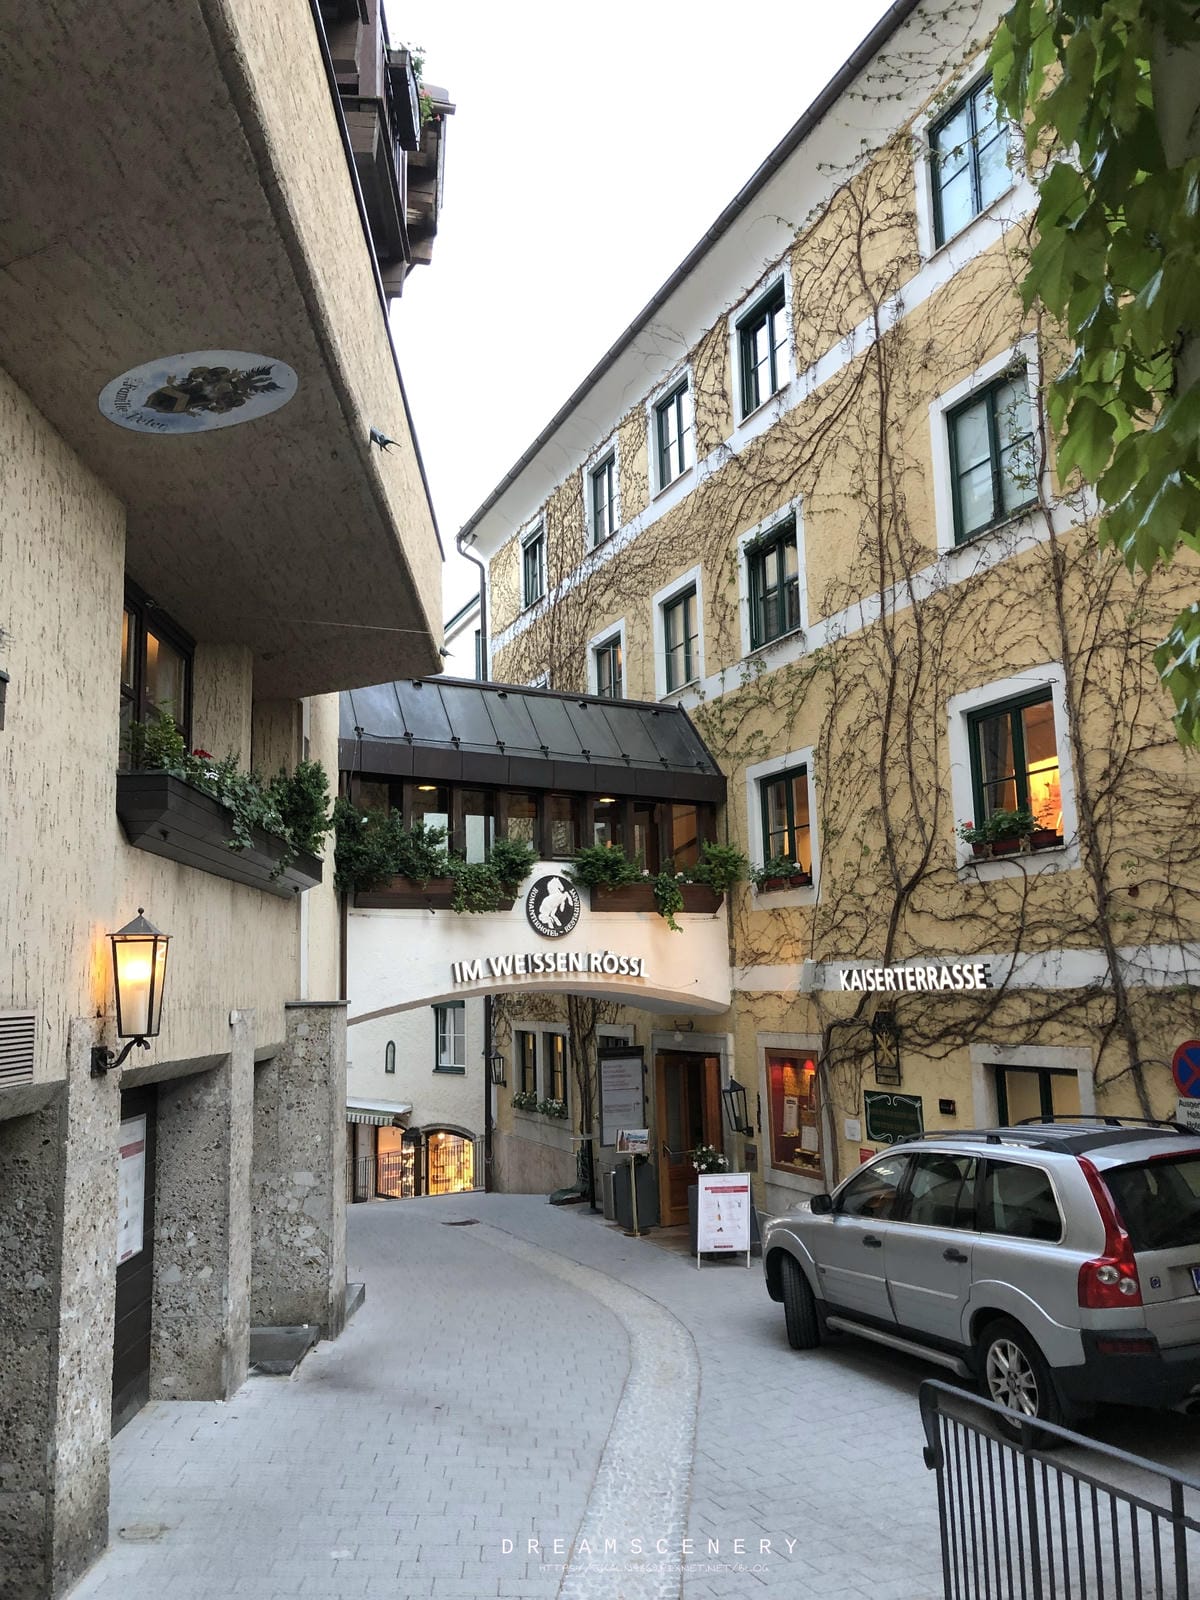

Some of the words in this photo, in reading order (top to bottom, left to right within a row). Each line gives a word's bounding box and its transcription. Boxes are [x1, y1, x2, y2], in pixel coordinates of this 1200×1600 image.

[452, 958, 484, 983] IM
[487, 952, 583, 978] WEISSEN
[588, 950, 649, 978] RÖSSL
[839, 963, 987, 992] KAISERTERRASSE
